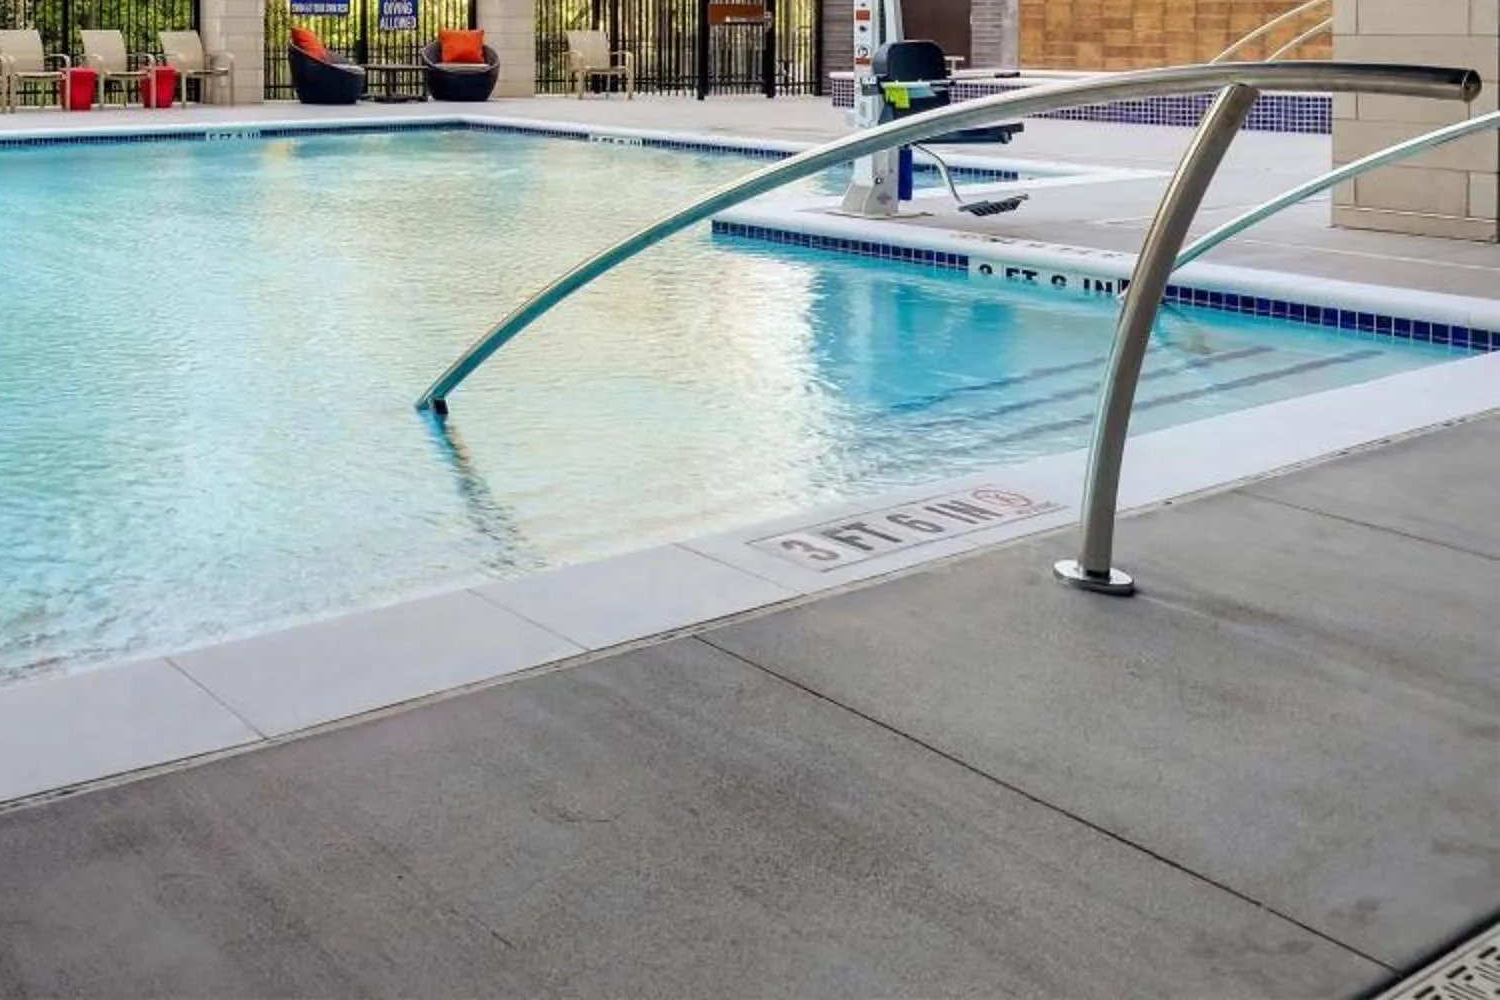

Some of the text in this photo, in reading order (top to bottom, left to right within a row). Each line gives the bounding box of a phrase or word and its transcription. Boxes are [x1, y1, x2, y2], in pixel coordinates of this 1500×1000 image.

[781, 539, 840, 561] 3
[820, 520, 903, 551] FT
[885, 512, 945, 533] 6
[923, 498, 1003, 524] IN
